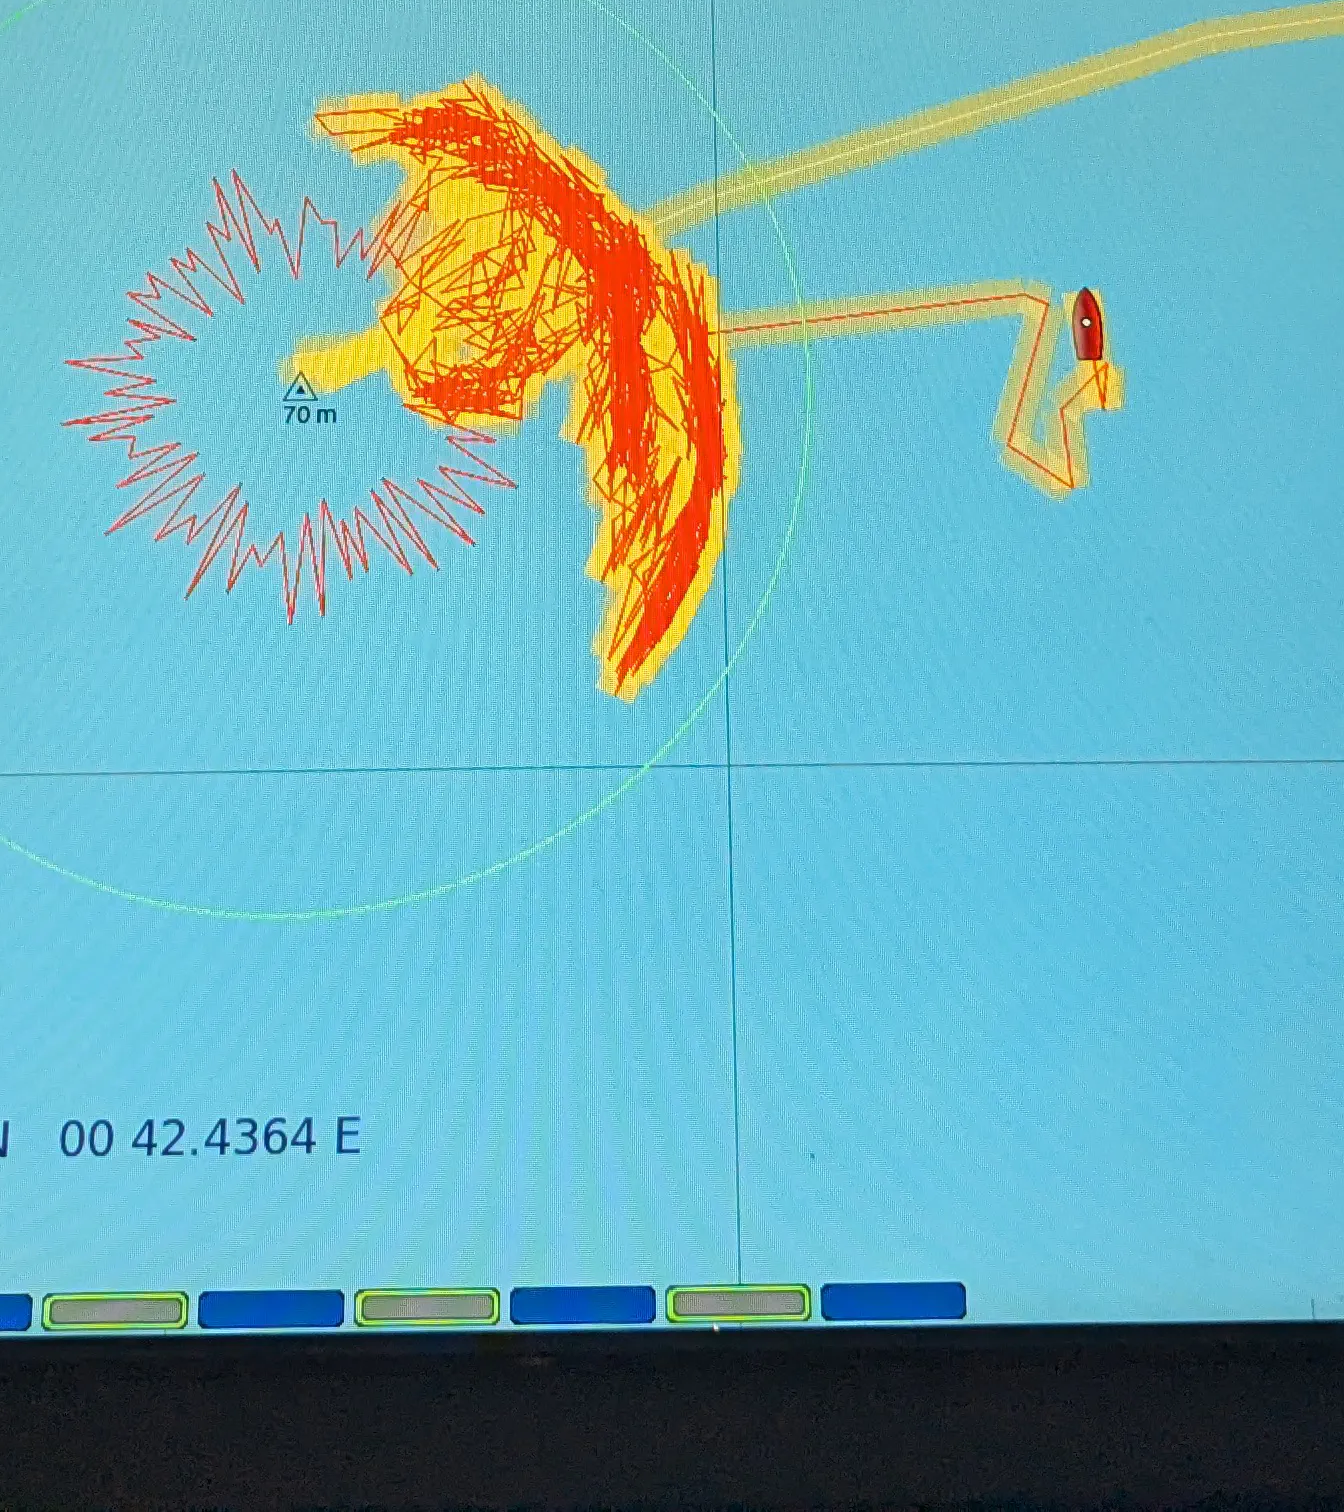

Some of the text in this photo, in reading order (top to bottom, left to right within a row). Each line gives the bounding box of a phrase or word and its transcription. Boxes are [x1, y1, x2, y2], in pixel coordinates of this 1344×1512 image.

[283, 405, 337, 424] 70 m
[59, 1119, 114, 1157] 00
[131, 1117, 317, 1157] 42.4364
[335, 1116, 362, 1154] E
